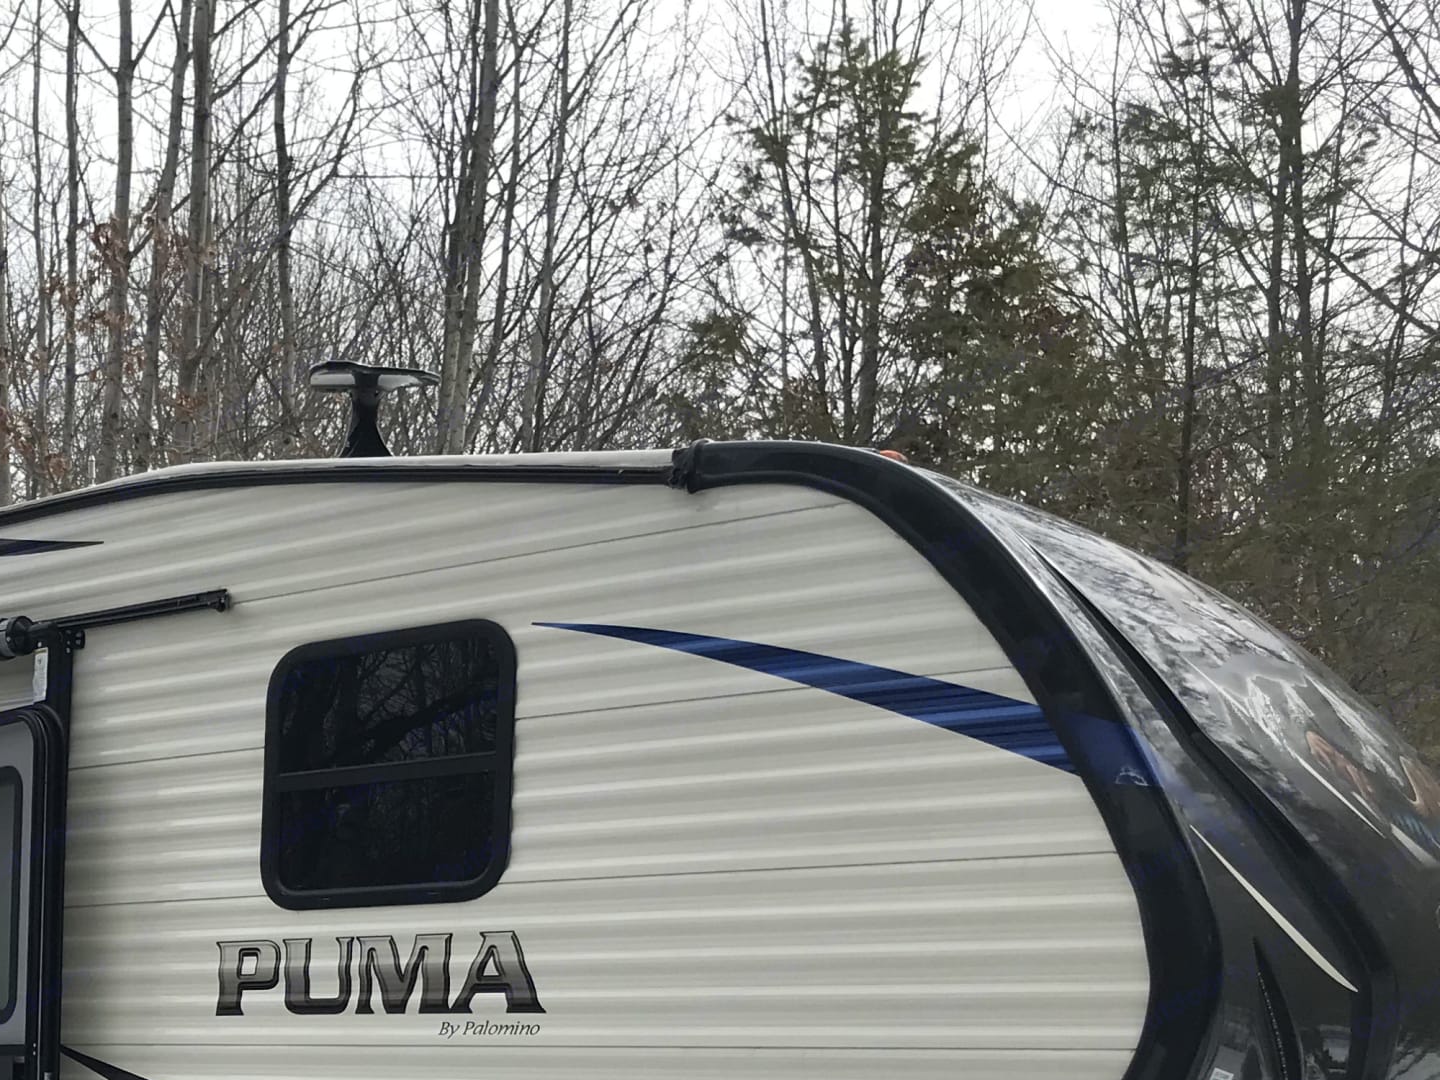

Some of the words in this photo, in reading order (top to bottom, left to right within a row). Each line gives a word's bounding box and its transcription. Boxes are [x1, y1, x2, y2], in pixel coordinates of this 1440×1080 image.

[216, 930, 547, 1016] PUMA
[438, 1021, 460, 1039] By
[462, 1019, 540, 1036] Palomino
